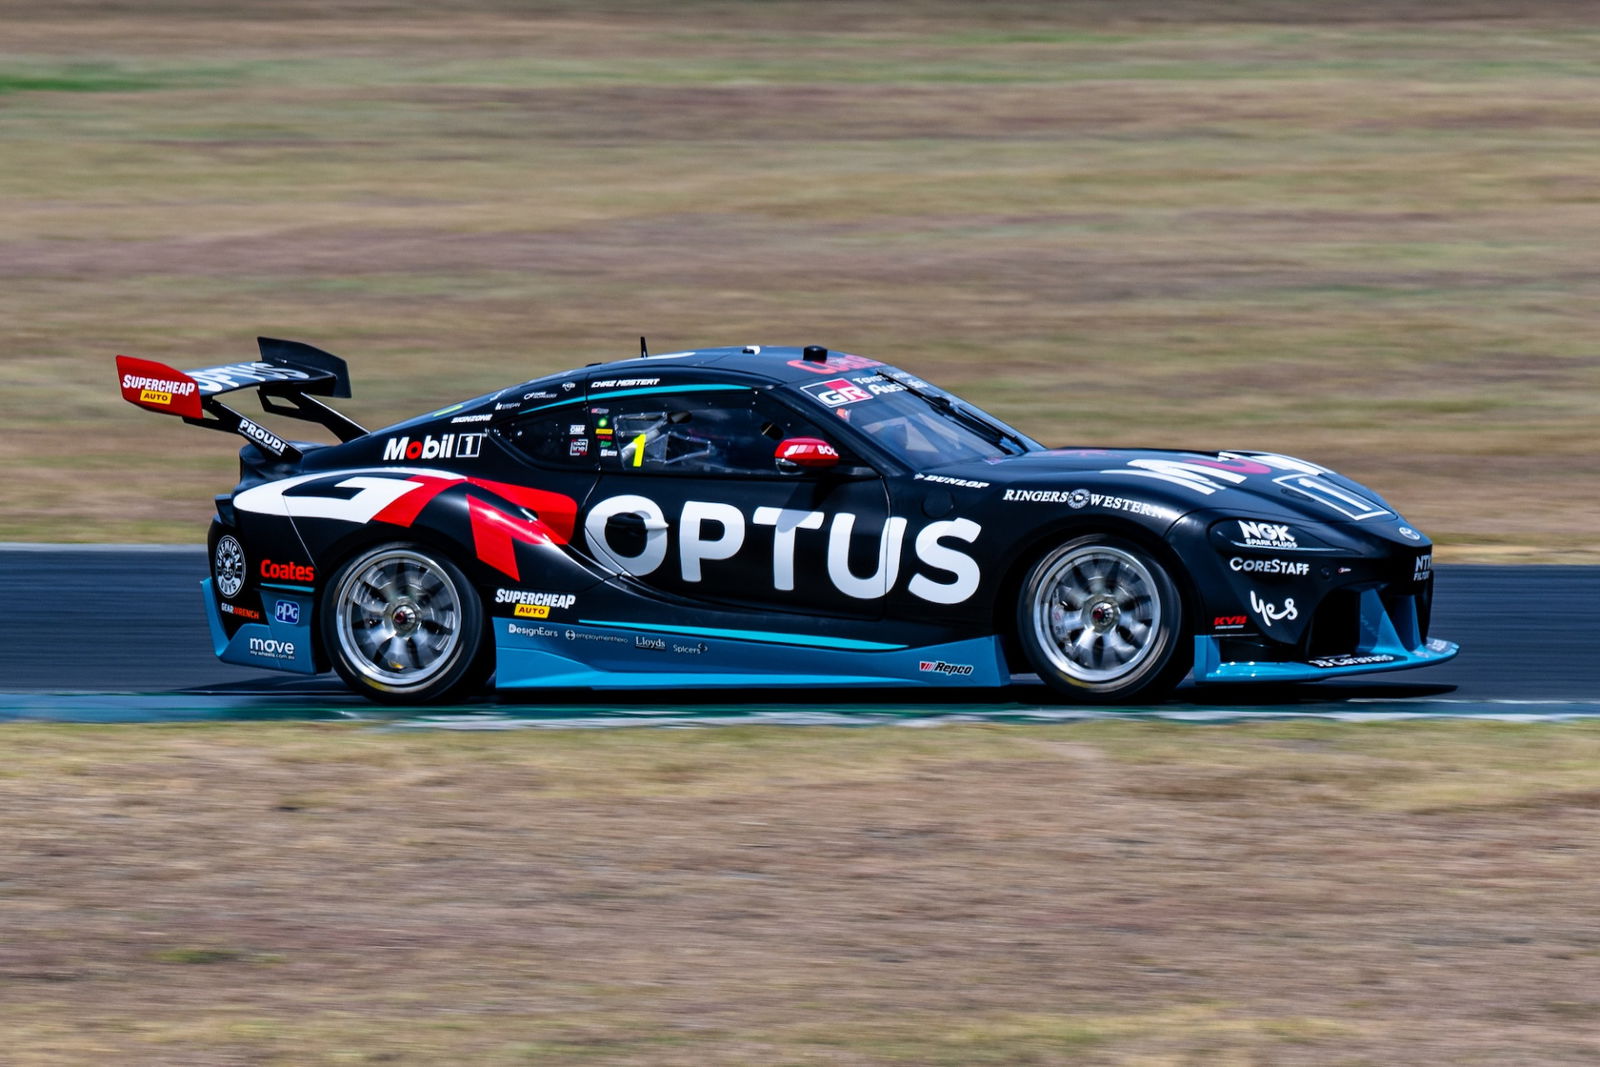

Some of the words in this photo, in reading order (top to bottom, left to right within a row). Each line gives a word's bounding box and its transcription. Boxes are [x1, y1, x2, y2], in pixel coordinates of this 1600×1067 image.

[122, 374, 195, 396] SUPERCHEAP
[143, 392, 168, 401] AUTO
[817, 386, 869, 405] GR
[383, 434, 455, 461] Mobil
[632, 433, 647, 467] 1
[924, 474, 991, 489] DUNLOP
[1003, 489, 1069, 503] RINGERS
[1090, 493, 1167, 519] WESTERN
[1238, 520, 1296, 542] NGK
[584, 494, 982, 604] OPTUS
[1245, 538, 1272, 547] SPARK
[1272, 540, 1298, 549] PLUGS
[217, 540, 242, 569] CHEMICAL
[260, 559, 315, 582] Coates
[219, 577, 242, 596] GUYS
[495, 588, 576, 609] SUPERCHEAP
[276, 602, 298, 620] PPG
[518, 606, 545, 616] AUTO
[508, 623, 559, 638] DesignEars
[249, 637, 295, 655] move
[635, 635, 666, 650] Lloyds
[934, 661, 974, 676] Repco
